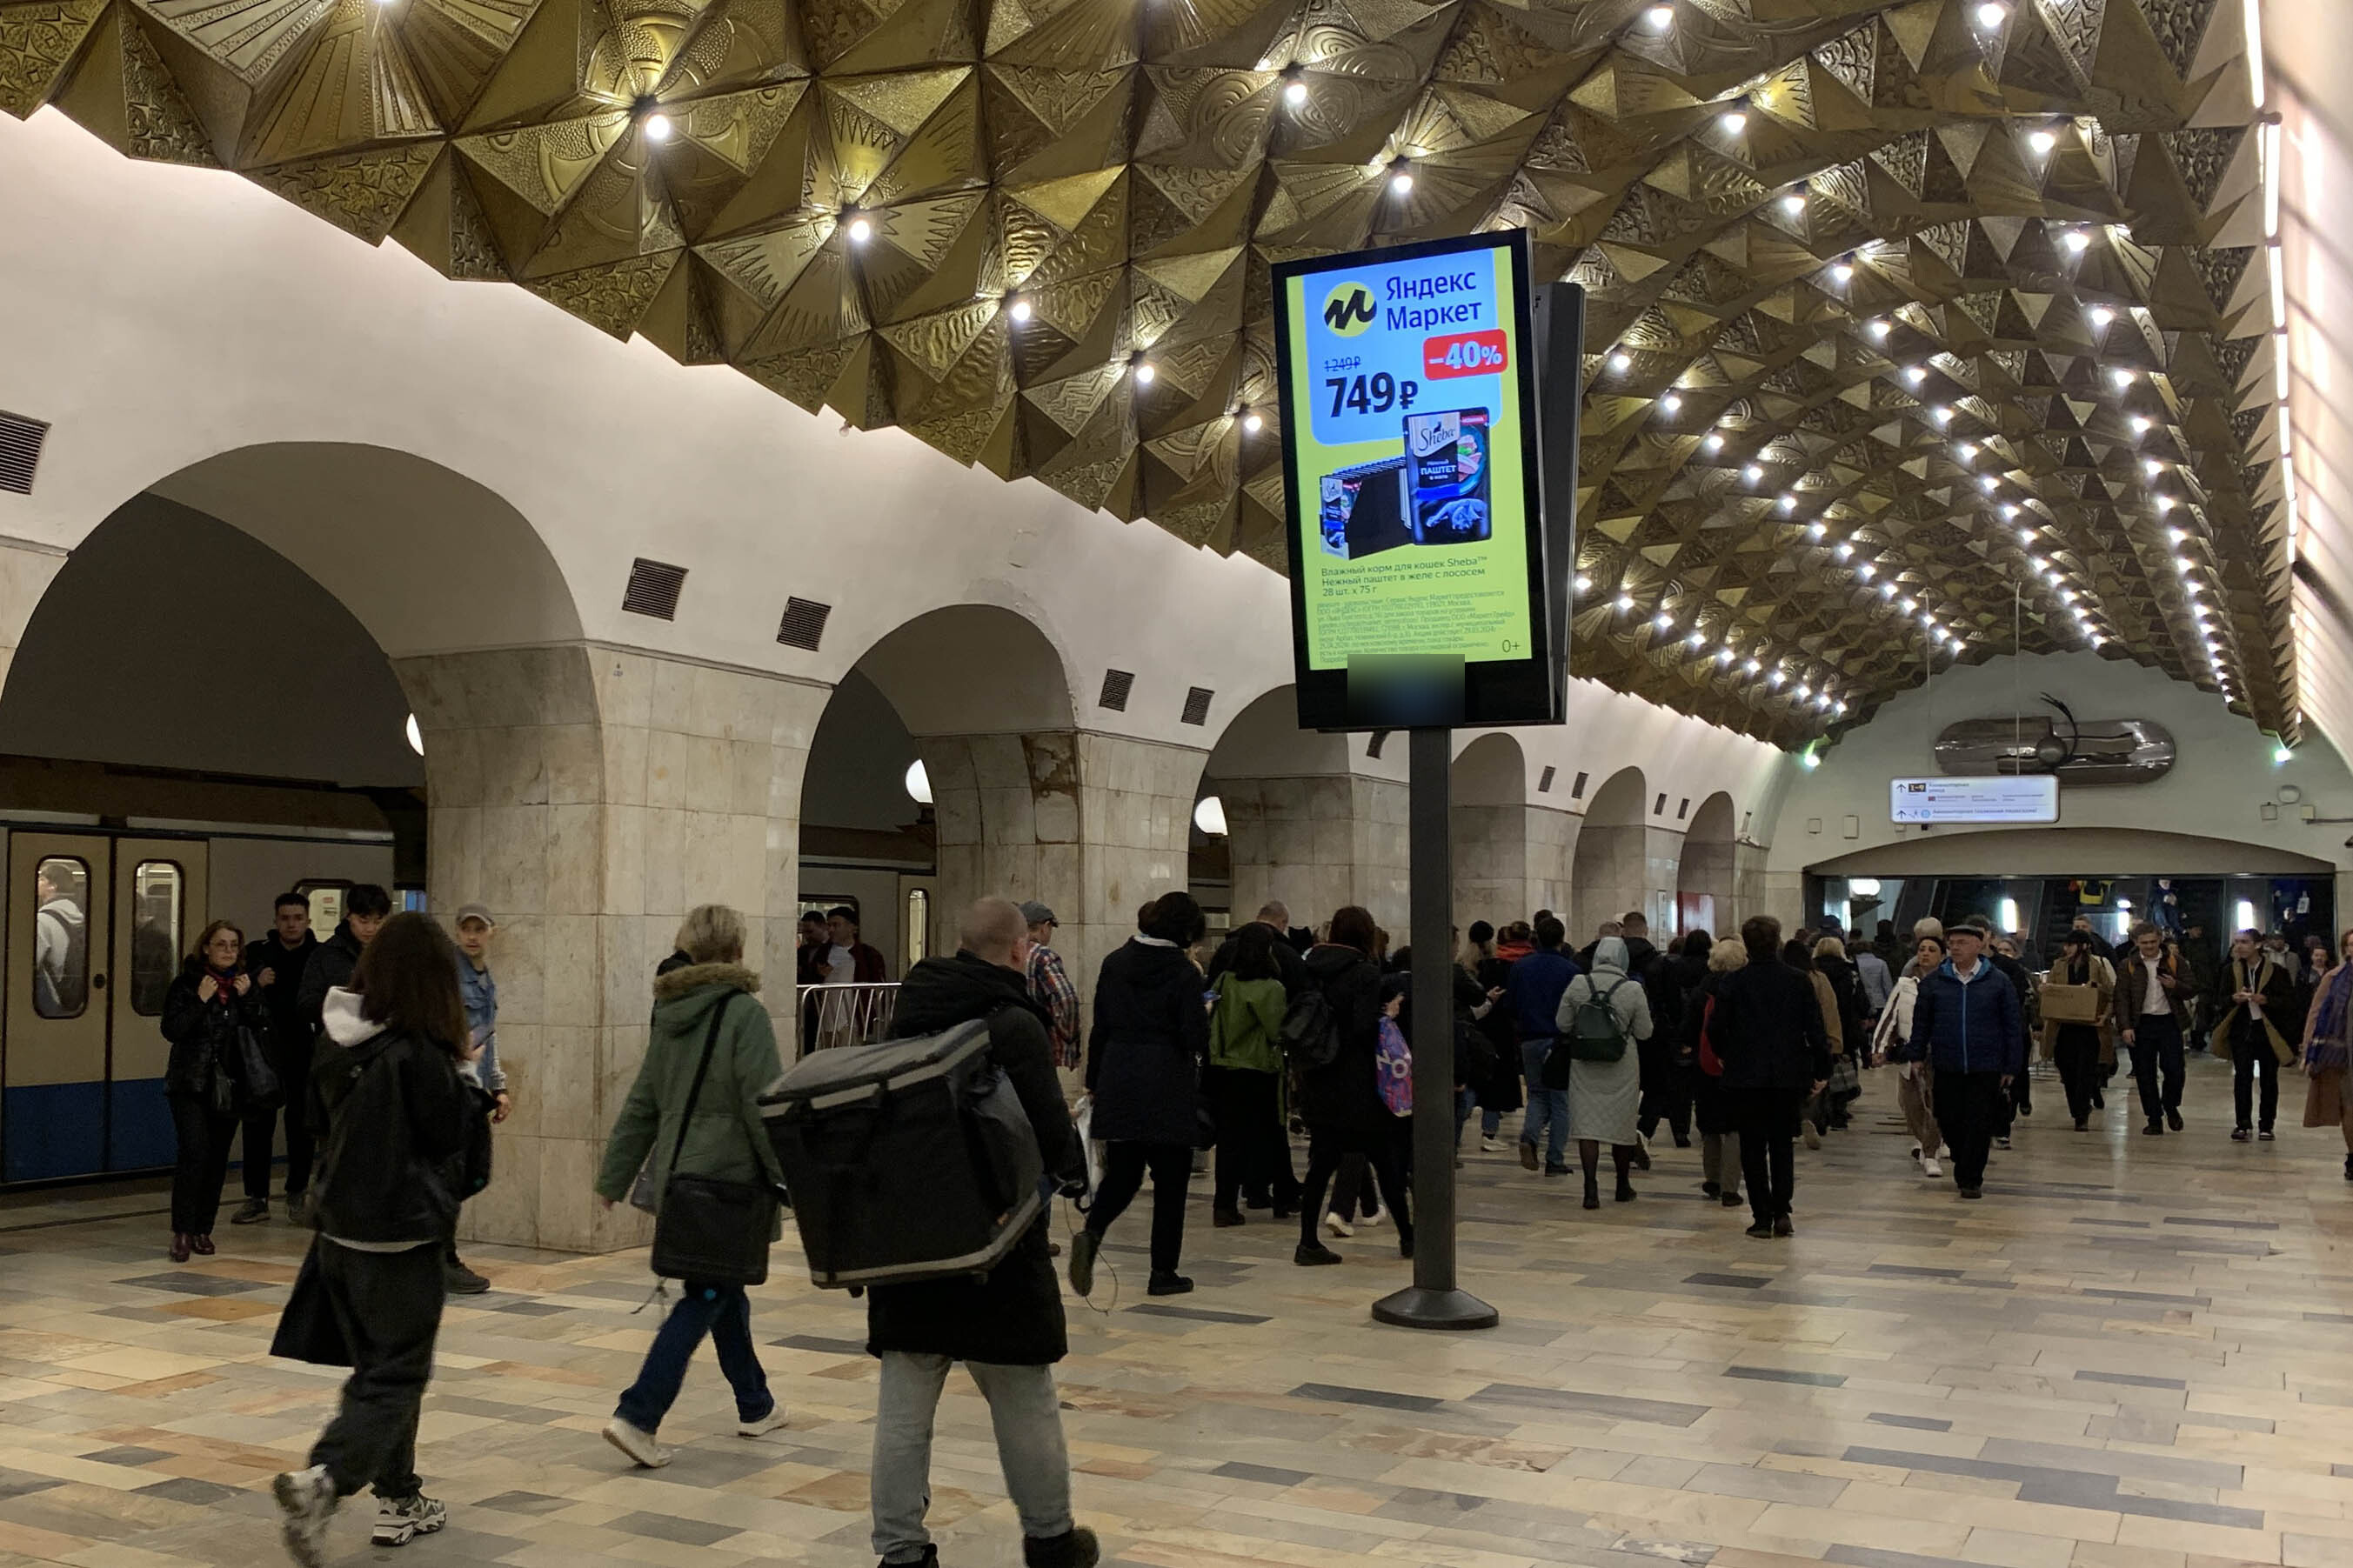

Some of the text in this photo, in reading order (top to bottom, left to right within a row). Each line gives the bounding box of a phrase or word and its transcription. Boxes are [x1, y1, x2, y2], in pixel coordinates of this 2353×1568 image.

[1386, 271, 1477, 302] Яндекс
[1387, 301, 1482, 331] Маркет
[1428, 340, 1503, 370] -40%
[1418, 427, 1456, 451] Sheba
[1420, 464, 1457, 475] ПАШТЕТ
[1321, 565, 1365, 577] Влажный
[1367, 564, 1392, 574] корм
[1394, 563, 1413, 571] для
[1414, 560, 1446, 570] кошек
[1322, 576, 1361, 587] Нежный
[1363, 574, 1397, 584] паштет
[1408, 570, 1434, 580] желе
[1442, 568, 1486, 577] лососем
[1322, 588, 1334, 597] 28
[1335, 588, 1350, 597] шт.
[1360, 585, 1371, 594] 75
[1502, 639, 1521, 653] 0+
